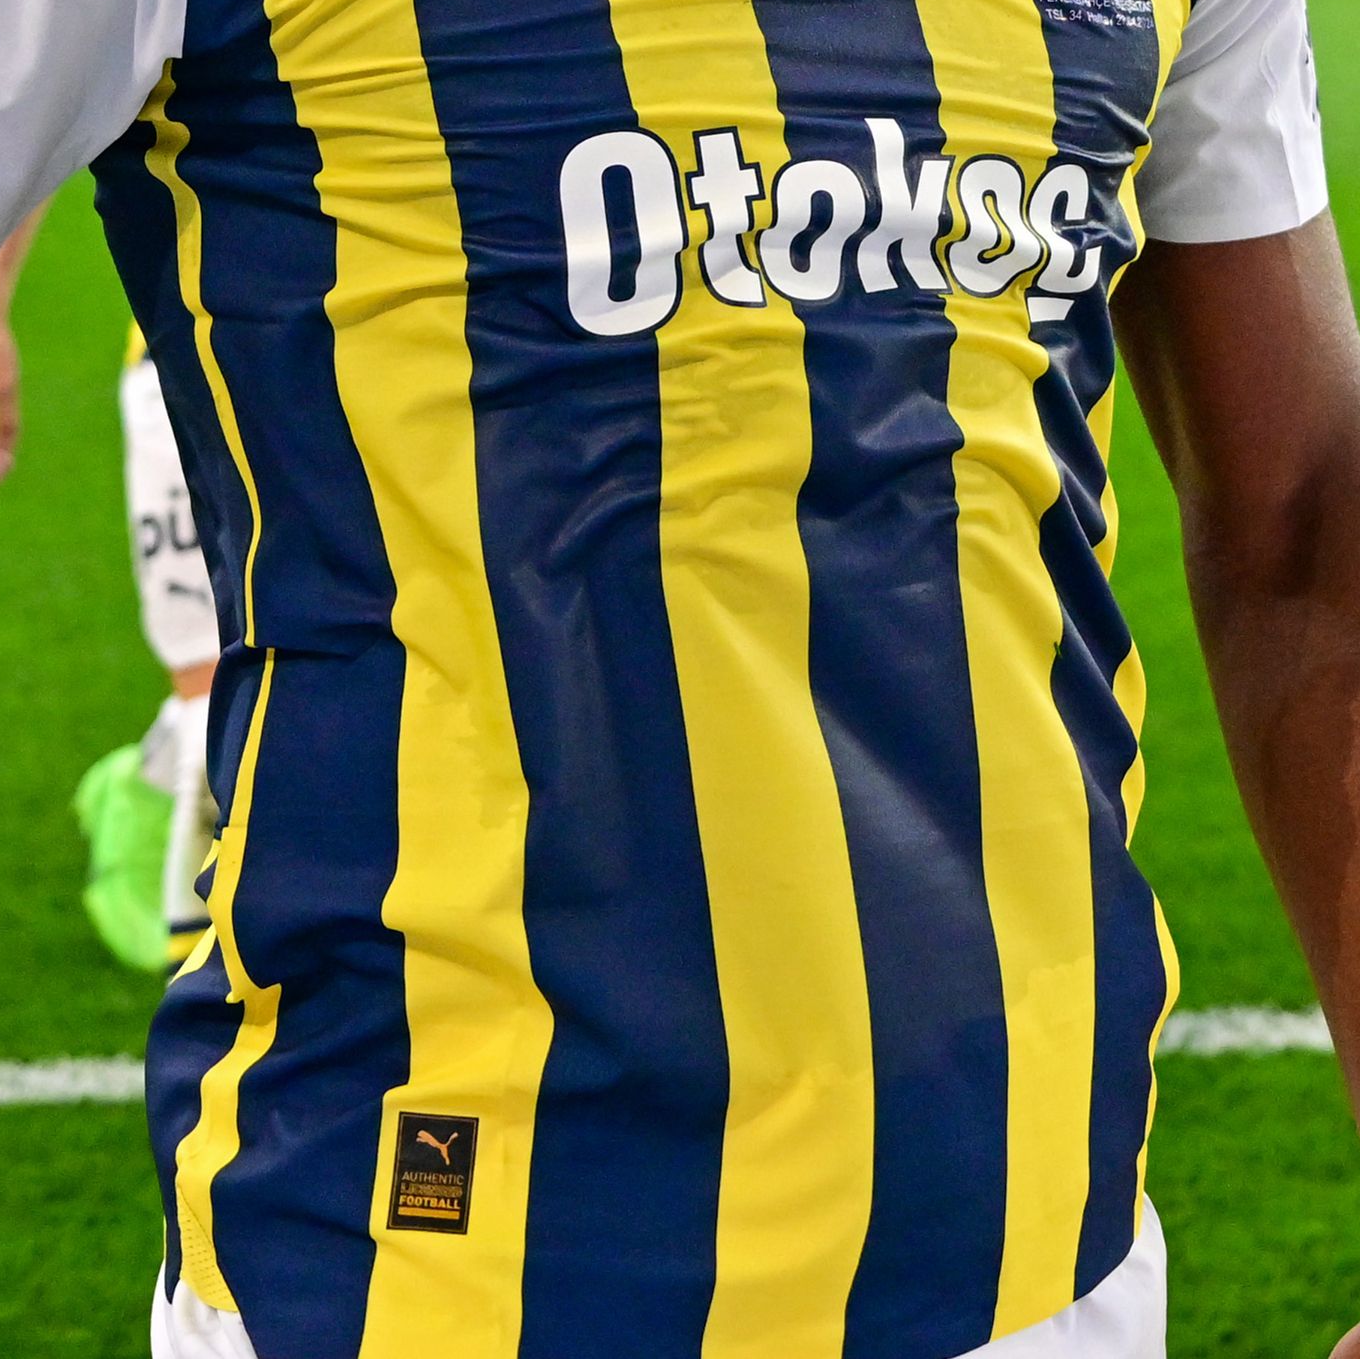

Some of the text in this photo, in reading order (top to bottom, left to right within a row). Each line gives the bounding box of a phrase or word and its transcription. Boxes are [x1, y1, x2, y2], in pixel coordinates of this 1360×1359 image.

[401, 171, 465, 186] AUTHENTIC
[398, 194, 461, 210] FOOTBALL
[558, 116, 1103, 337] Otokoç
